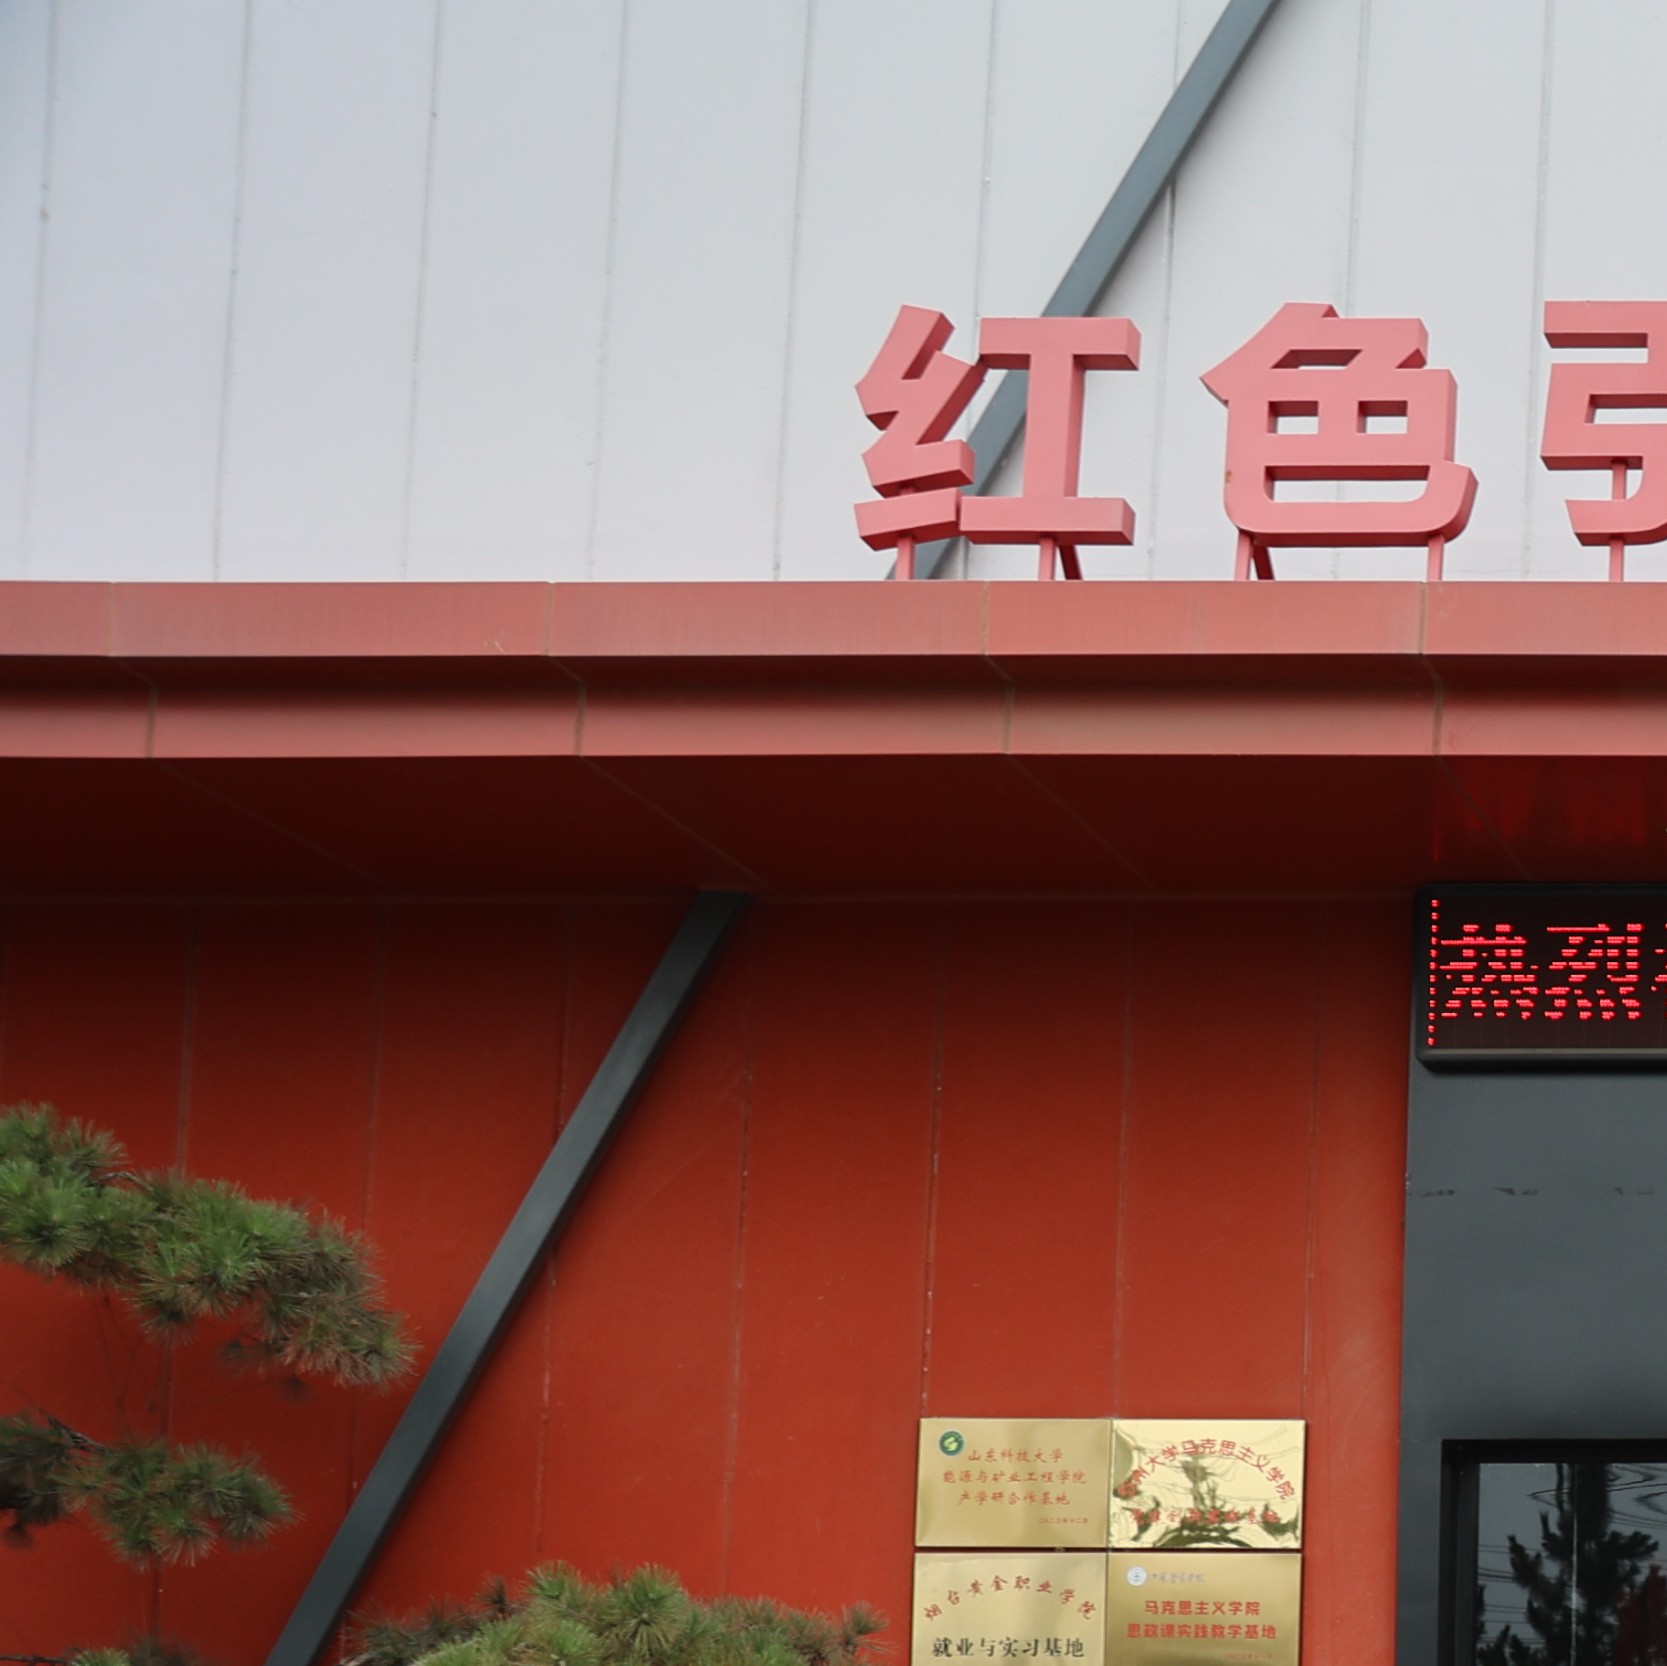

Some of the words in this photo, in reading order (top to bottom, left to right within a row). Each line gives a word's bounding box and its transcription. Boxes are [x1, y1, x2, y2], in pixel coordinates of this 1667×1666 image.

[967, 1448, 1064, 1463] 山东科技大学
[943, 1469, 1087, 1485] 能源与矿业工程学院
[958, 1491, 1070, 1506] 产学研合作基地
[1144, 1600, 1261, 1616] 马克思主义学院
[1127, 1623, 1277, 1640] 思政课实践教学基地
[931, 1636, 1084, 1658] 就业与实习基地
